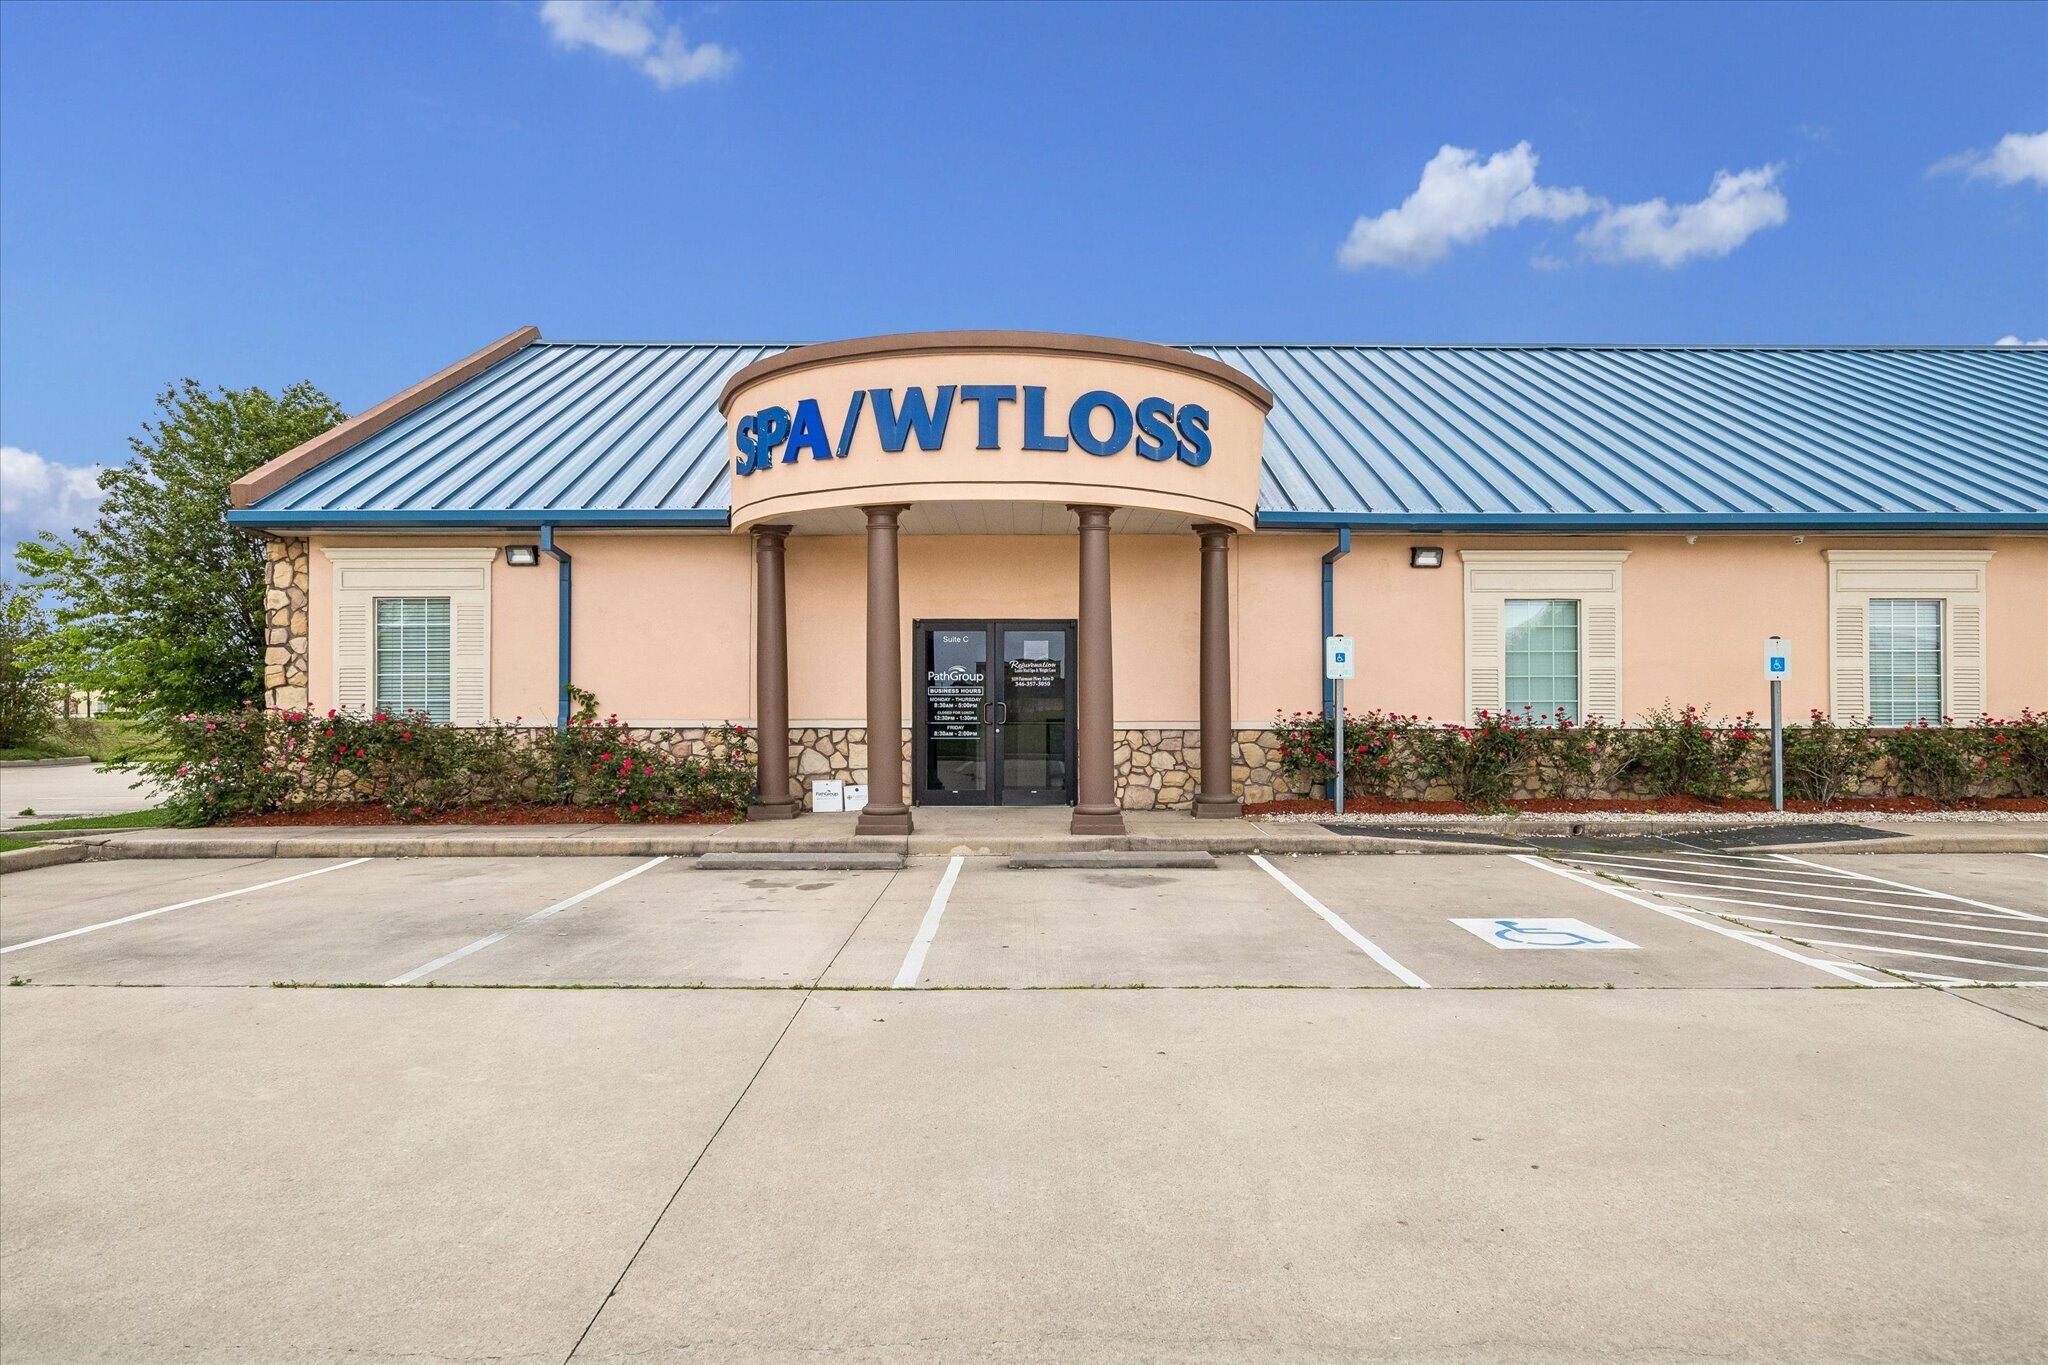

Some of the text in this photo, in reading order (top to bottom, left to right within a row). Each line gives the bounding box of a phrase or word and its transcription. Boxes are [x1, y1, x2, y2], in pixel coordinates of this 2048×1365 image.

[943, 635, 969, 643] Suite C
[1009, 660, 1056, 669] Rejuvenation
[928, 671, 984, 683] PathGroup
